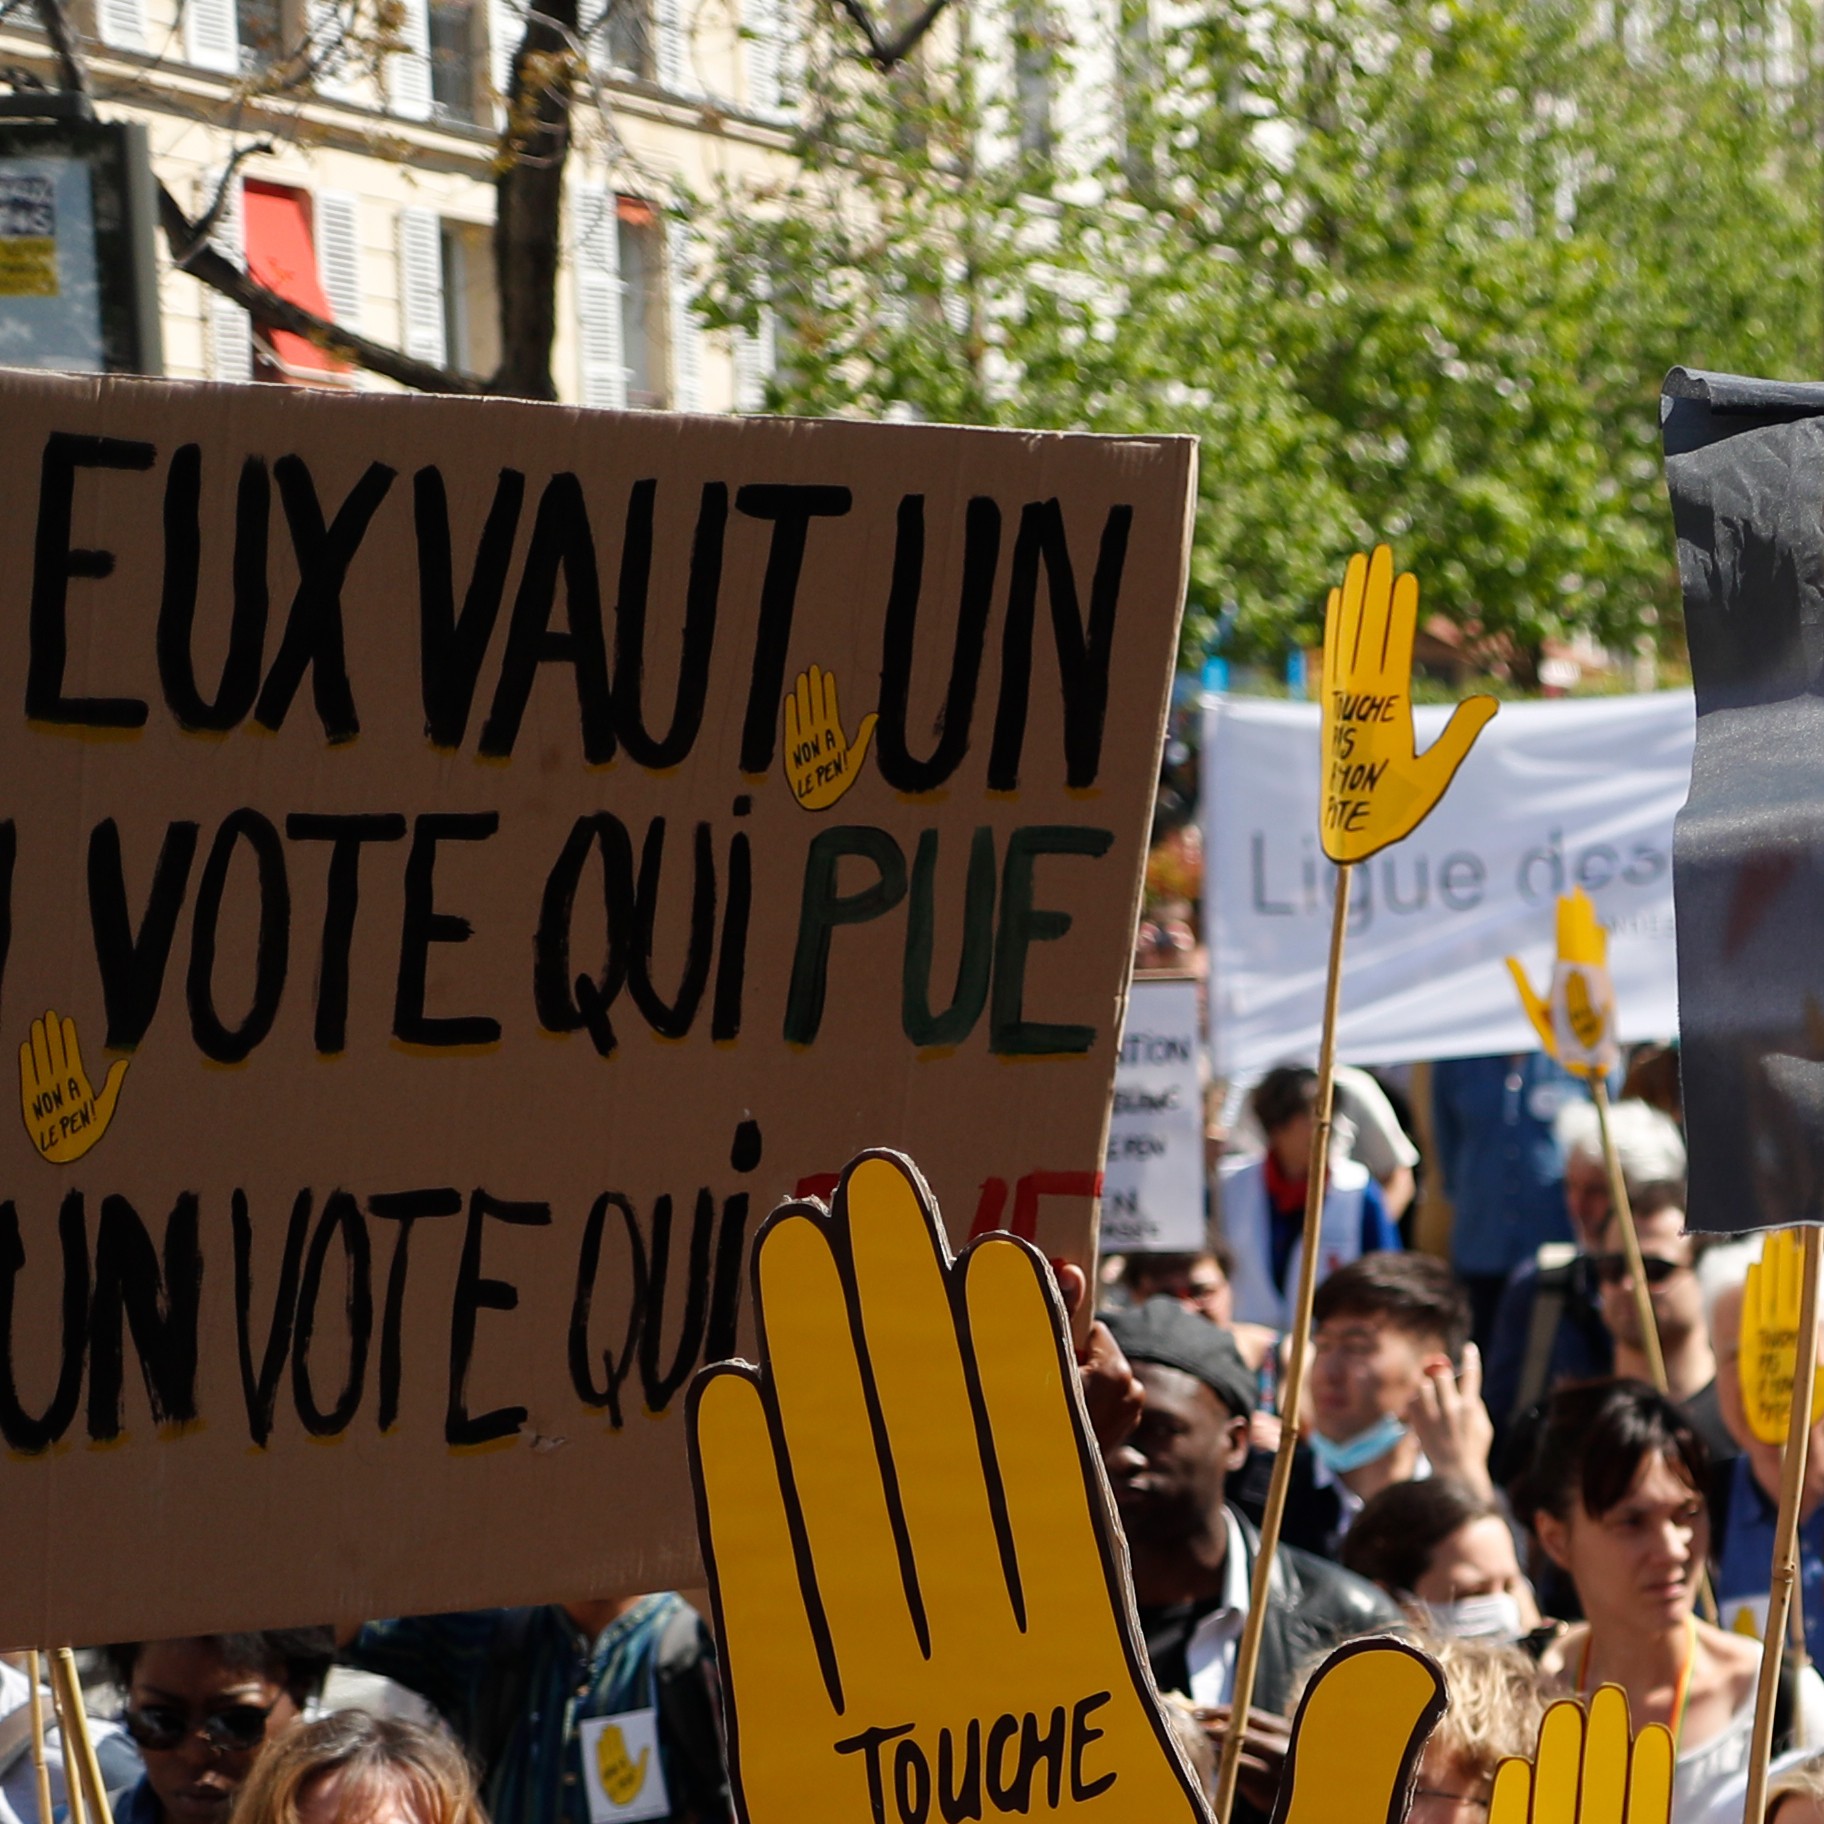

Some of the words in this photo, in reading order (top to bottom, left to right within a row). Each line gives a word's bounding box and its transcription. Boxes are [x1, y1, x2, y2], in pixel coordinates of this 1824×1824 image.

[25, 431, 398, 745] EUX
[412, 464, 853, 776] VAUT
[876, 494, 1134, 797] UN
[793, 733, 821, 769] NON
[825, 729, 836, 751] A
[797, 774, 814, 798] LE
[816, 749, 848, 786] PEN!
[87, 805, 502, 1062] VOTE
[783, 823, 1116, 1055] PUE
[33, 1083, 63, 1120] NON
[68, 1077, 81, 1100] A
[40, 1125, 59, 1152] LE
[60, 1098, 97, 1138] PEN!
[0, 1188, 202, 1456] UN
[232, 1184, 553, 1447] VOTE
